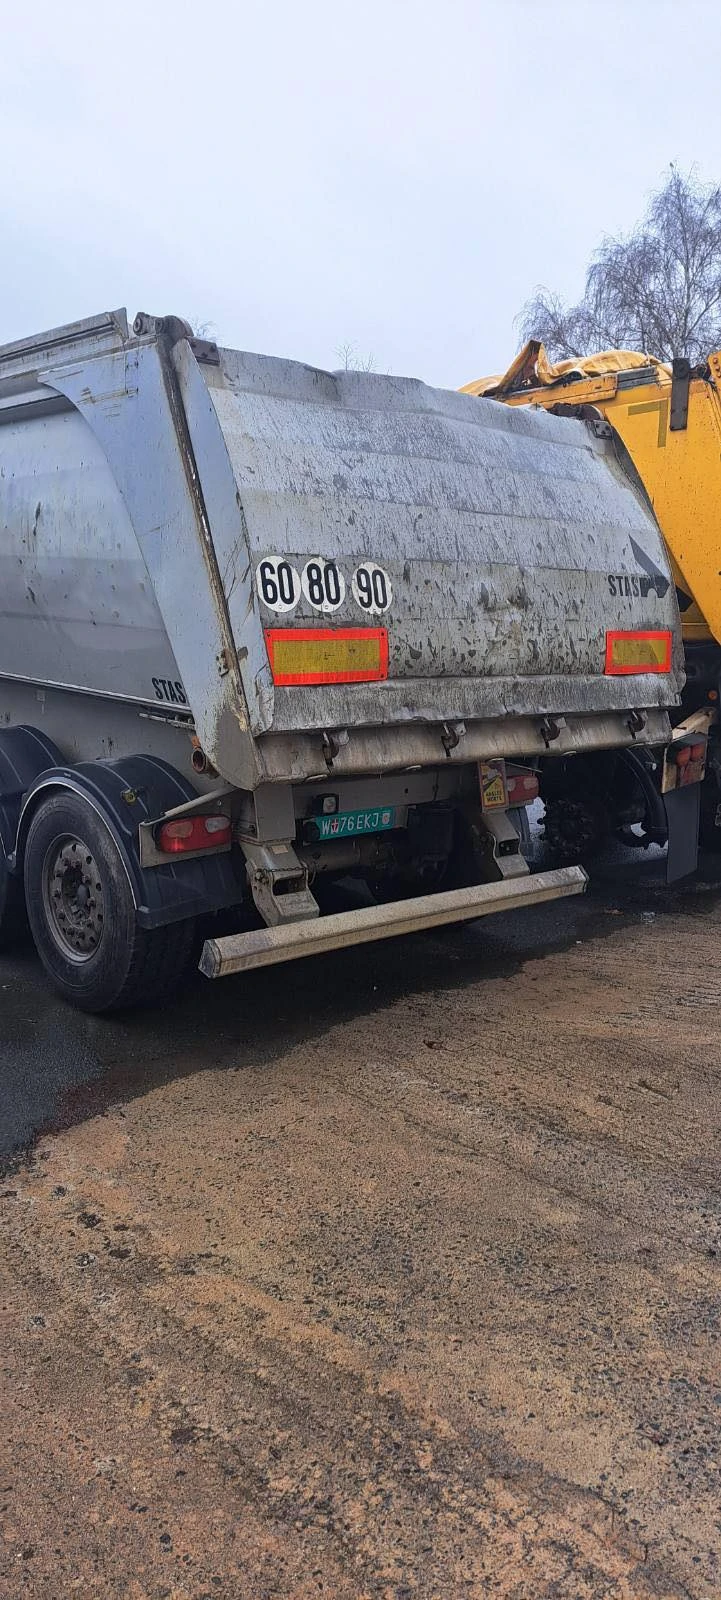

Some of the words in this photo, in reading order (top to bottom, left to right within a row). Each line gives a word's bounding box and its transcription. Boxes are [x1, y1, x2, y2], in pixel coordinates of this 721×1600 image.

[259, 561, 295, 605] 60
[306, 563, 341, 605] 80
[356, 568, 388, 609] 90
[607, 574, 640, 597] STAS
[151, 677, 187, 704] STAS
